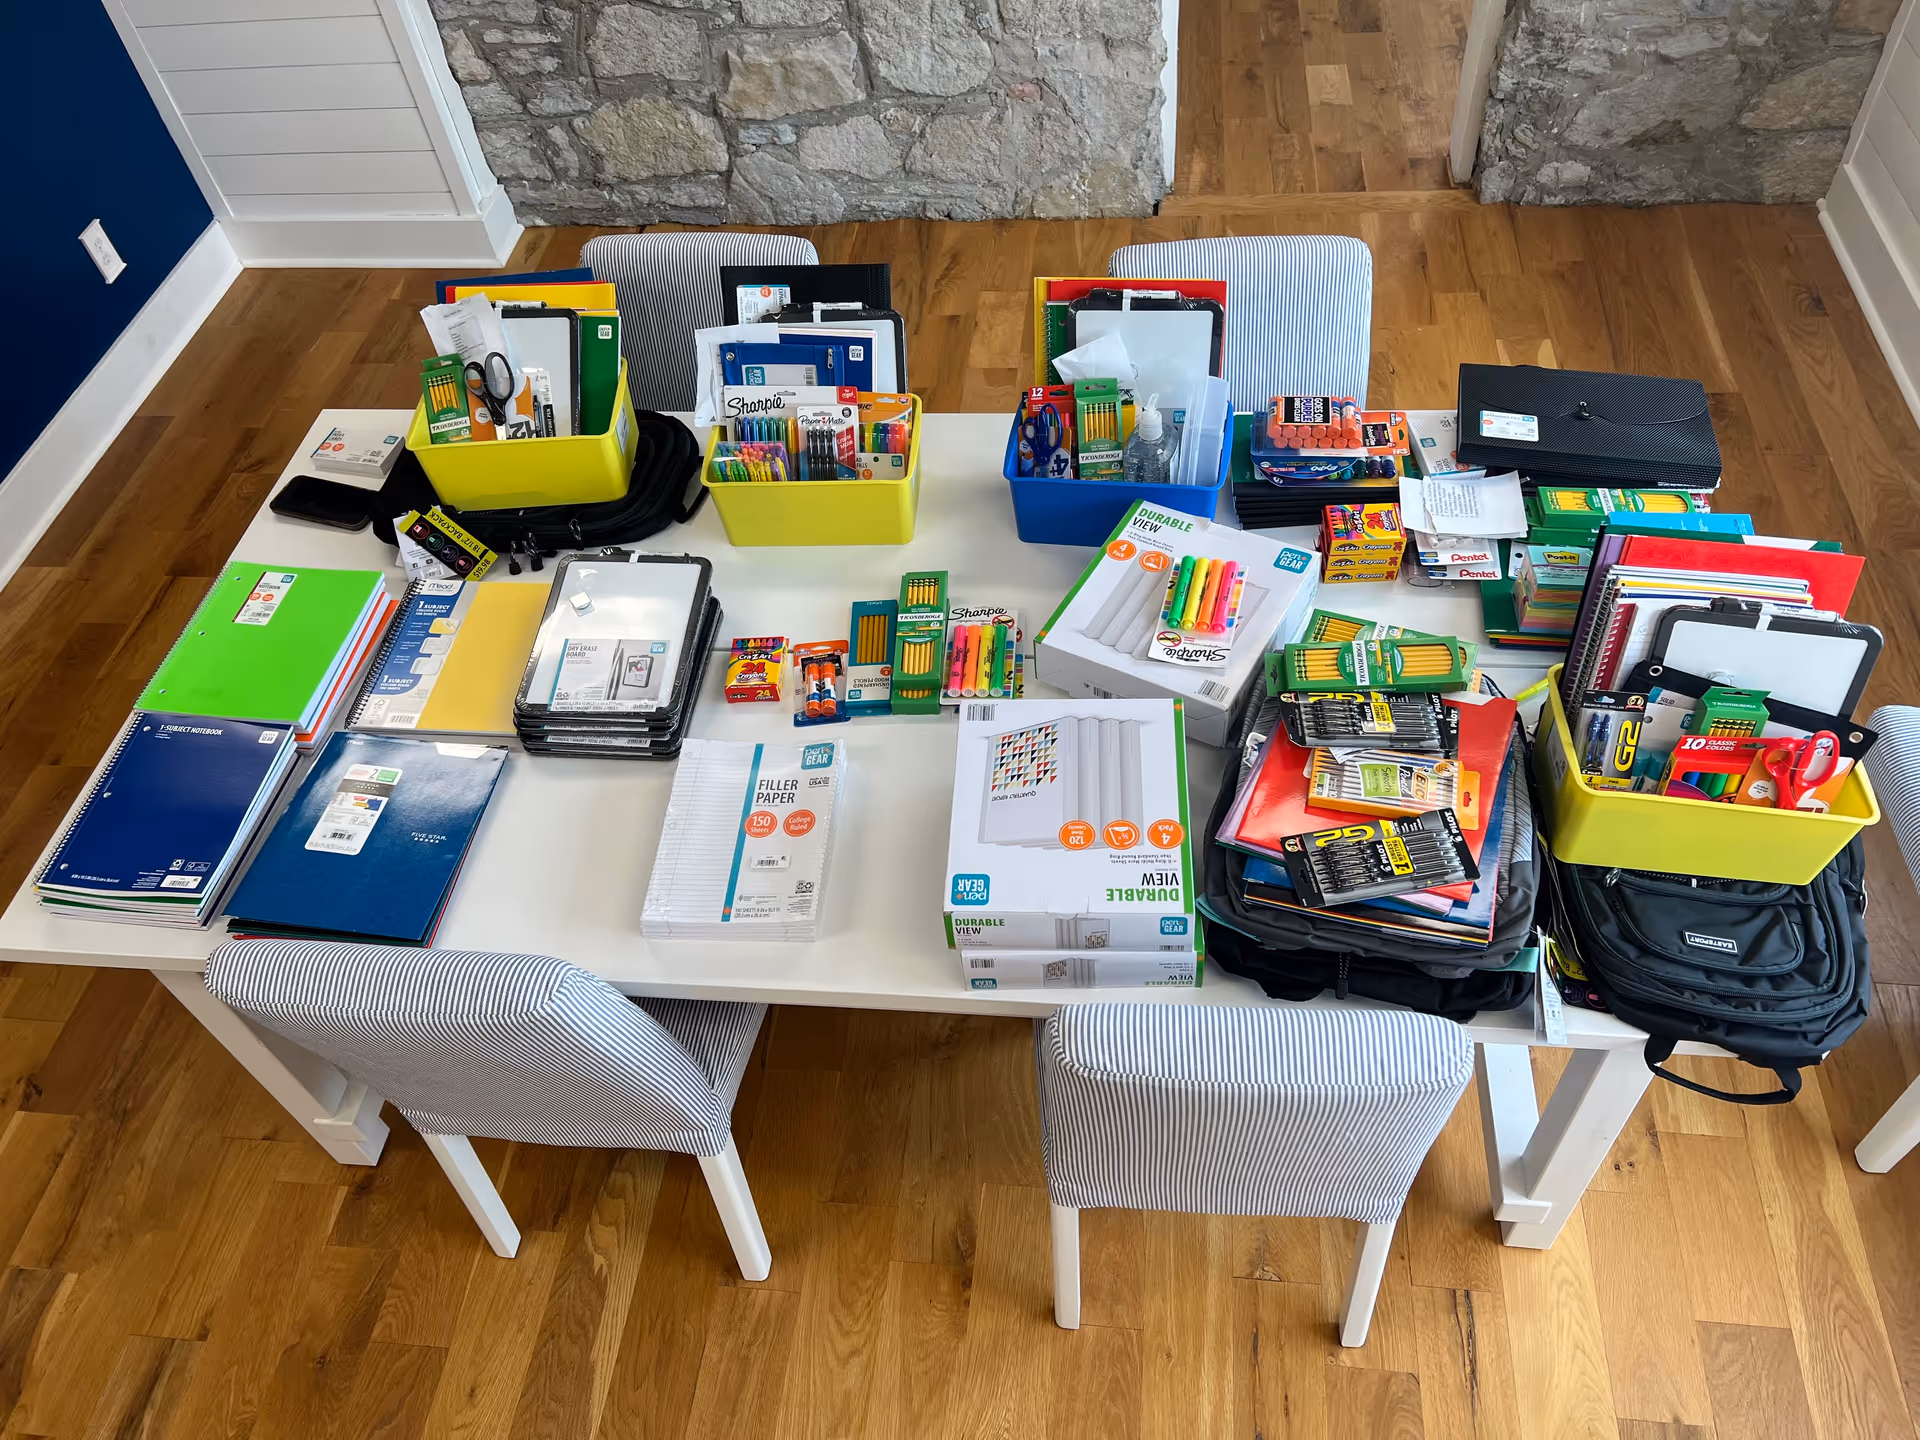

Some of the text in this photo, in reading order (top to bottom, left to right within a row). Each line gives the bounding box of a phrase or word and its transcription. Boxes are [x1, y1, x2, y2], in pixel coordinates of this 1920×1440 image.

[1031, 387, 1044, 397] 12
[726, 394, 785, 418] Sharpie
[1301, 397, 1314, 423] PURPLE
[1314, 397, 1323, 423] GOES ON
[431, 419, 468, 431] TICONDEROGA
[798, 415, 846, 425] Paper Mate
[1080, 452, 1121, 461] TICONDEROGA
[428, 511, 463, 540] BACKPACK
[1133, 517, 1162, 533] VIEW
[1138, 508, 1194, 532] DURABLE
[1365, 513, 1384, 529] 24
[473, 545, 480, 553] 18
[1112, 549, 1125, 558] Pack
[1119, 544, 1128, 552] 4
[1281, 550, 1301, 561] pen
[1451, 553, 1490, 563] Pentel
[1546, 554, 1578, 562] Post-it
[473, 558, 491, 578] $19.98
[1280, 557, 1302, 570] GEAR
[1459, 569, 1498, 578] Pentel
[428, 582, 454, 590] Mead
[418, 600, 424, 608] 1
[949, 606, 1007, 620] Sharpie
[1164, 647, 1230, 663] Sharpie
[741, 662, 766, 674] 24
[1355, 642, 1366, 684] TICONDEROGA
[382, 675, 389, 683] 1
[736, 672, 767, 680] Crayons
[756, 689, 771, 697] 24
[1431, 694, 1440, 713] PILOT
[1660, 696, 1675, 705] SOLID
[1711, 701, 1757, 709] TICONDEROGA
[1364, 705, 1372, 721] PILOT
[160, 724, 224, 736] 1-SUBJECT NOTEBOOK
[1614, 720, 1641, 772] G2
[1680, 737, 1738, 750] 10 CLASSIC
[806, 753, 829, 766] GEAR
[368, 768, 379, 780] 2
[1380, 766, 1391, 793] Smooth
[758, 780, 799, 791] FILLER
[1400, 766, 1411, 795] Pencil
[1414, 773, 1427, 800] BIC
[756, 792, 796, 804] PAPER
[752, 816, 771, 827] 150
[788, 816, 811, 824] College
[1444, 811, 1459, 835] PILOT
[1069, 836, 1085, 845] 120
[1161, 833, 1171, 845] 4
[1376, 843, 1387, 864] PILOT
[957, 879, 984, 892] GEAR
[1141, 873, 1179, 886] VIEW
[963, 888, 987, 900] pen
[1106, 888, 1179, 901] DURABLE
[955, 918, 1005, 927] DURABLE
[955, 927, 981, 935] VIEW
[1164, 925, 1184, 933] GEAR
[1689, 936, 1733, 949] EASTSPORT
